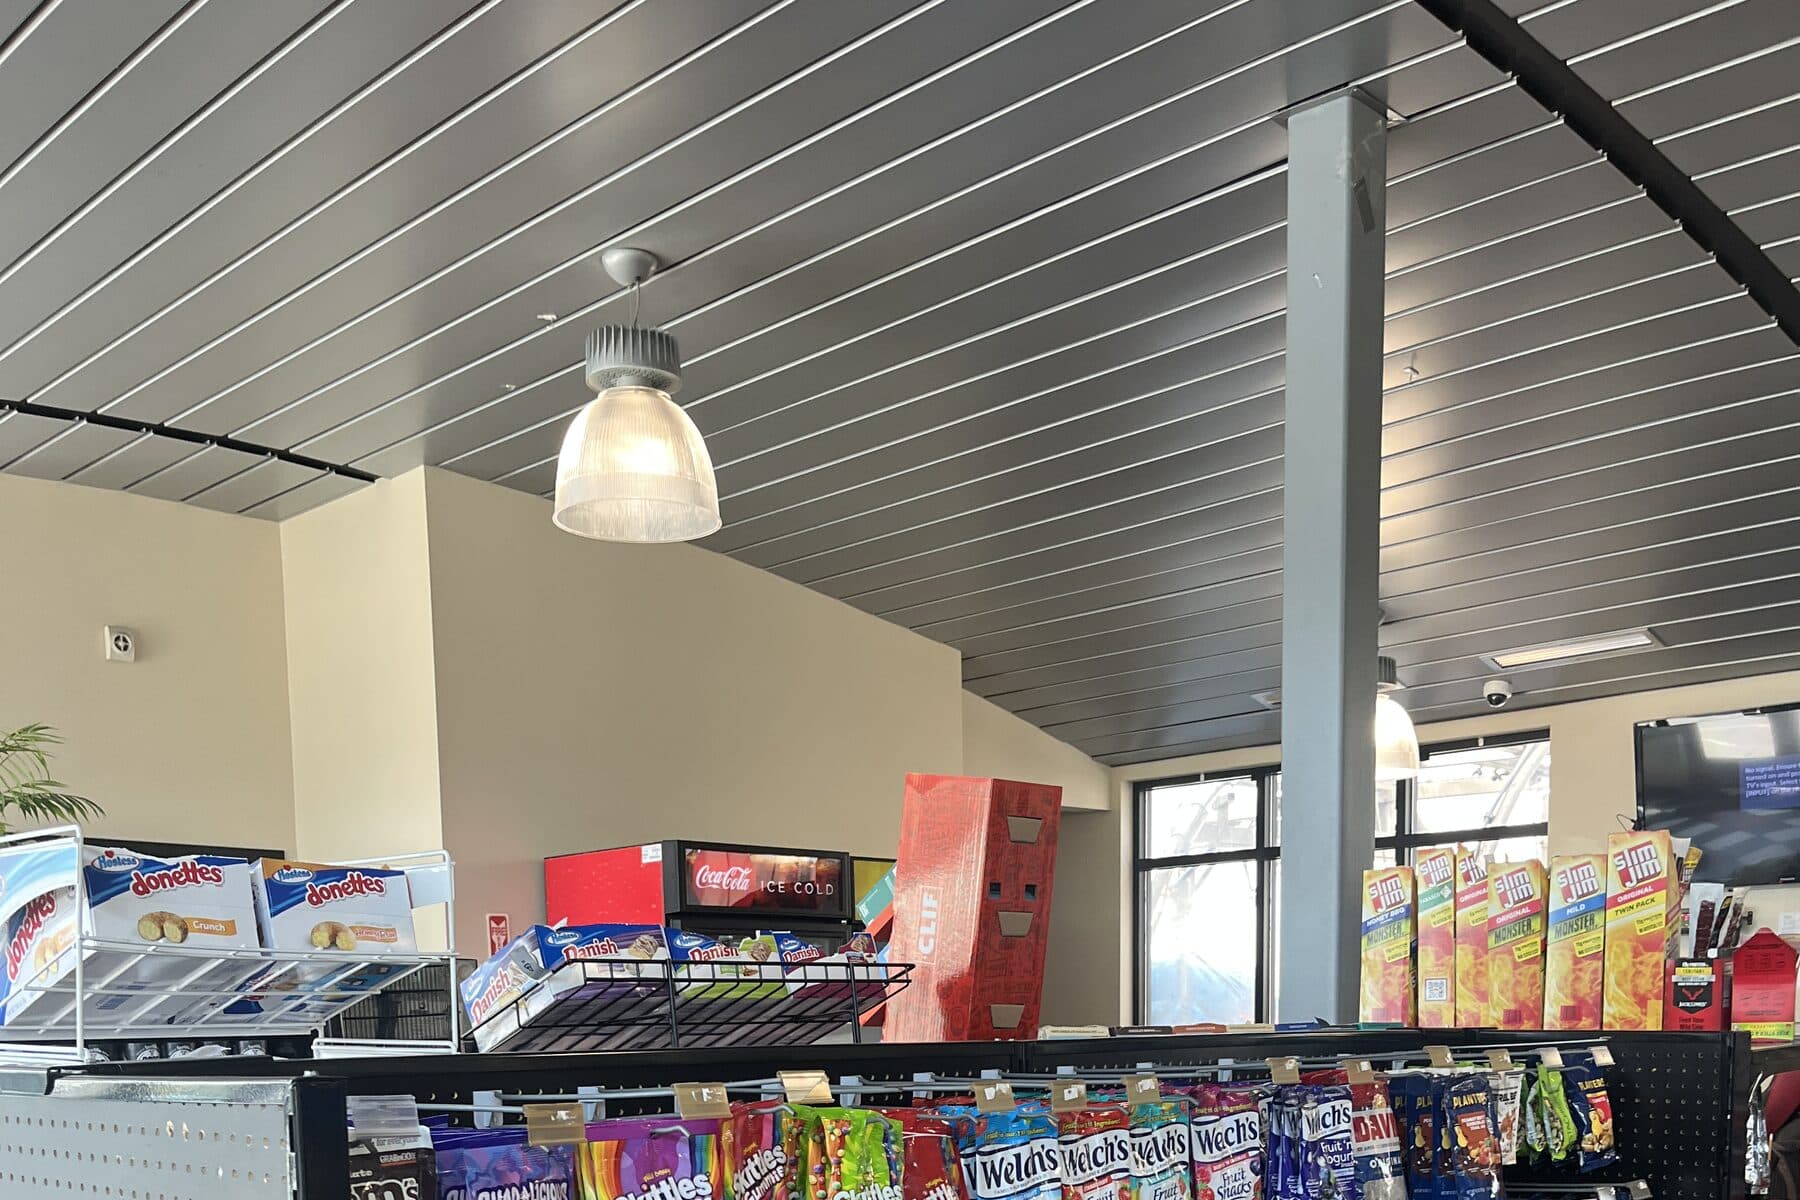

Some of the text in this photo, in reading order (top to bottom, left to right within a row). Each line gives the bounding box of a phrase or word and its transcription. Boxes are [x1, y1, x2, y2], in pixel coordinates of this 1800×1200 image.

[98, 853, 138, 870] Hostess
[131, 861, 224, 897] donettes
[277, 867, 313, 882] Hostess
[696, 864, 752, 892] Coca-Cola
[305, 872, 387, 908] donettes
[760, 881, 834, 896] ICE COLD
[1616, 886, 1654, 903] ORIGINAL
[1496, 907, 1532, 924] ORIGINAL
[1614, 897, 1656, 916] TWIN PACK
[193, 920, 226, 932] Crunch
[922, 892, 940, 955] CLIF
[1366, 921, 1404, 946] MONSTER
[1493, 919, 1535, 945] MONSTER
[1554, 914, 1597, 940] MONSTER
[563, 937, 619, 961] Danish
[689, 947, 741, 967] Danish
[784, 944, 820, 963] Danish
[471, 968, 512, 1026] Danish
[1061, 1133, 1129, 1178] Welch's
[1320, 1140, 1343, 1153] Fruit
[1222, 1166, 1247, 1187] Fruit
